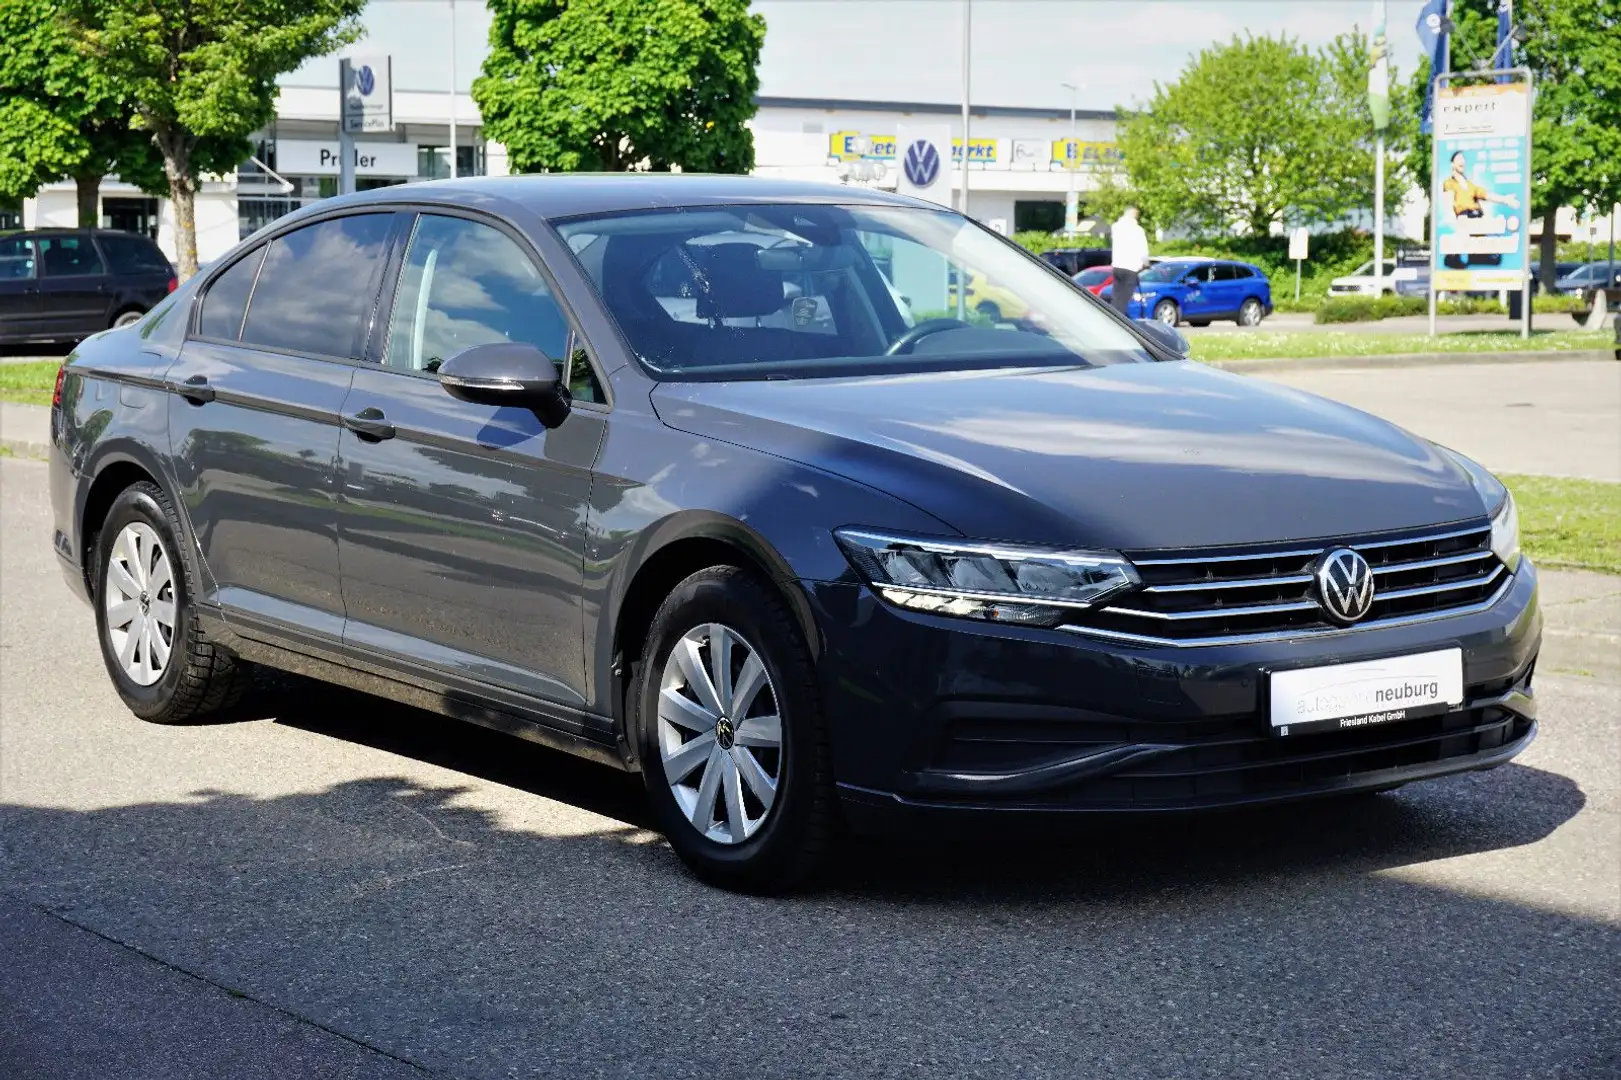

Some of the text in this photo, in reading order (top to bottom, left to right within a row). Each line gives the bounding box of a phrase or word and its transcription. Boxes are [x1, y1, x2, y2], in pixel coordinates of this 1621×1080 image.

[320, 149, 377, 168] Prler
[1375, 681, 1438, 702] neuburg
[1340, 709, 1406, 728] Friesland Kabel GmbH
